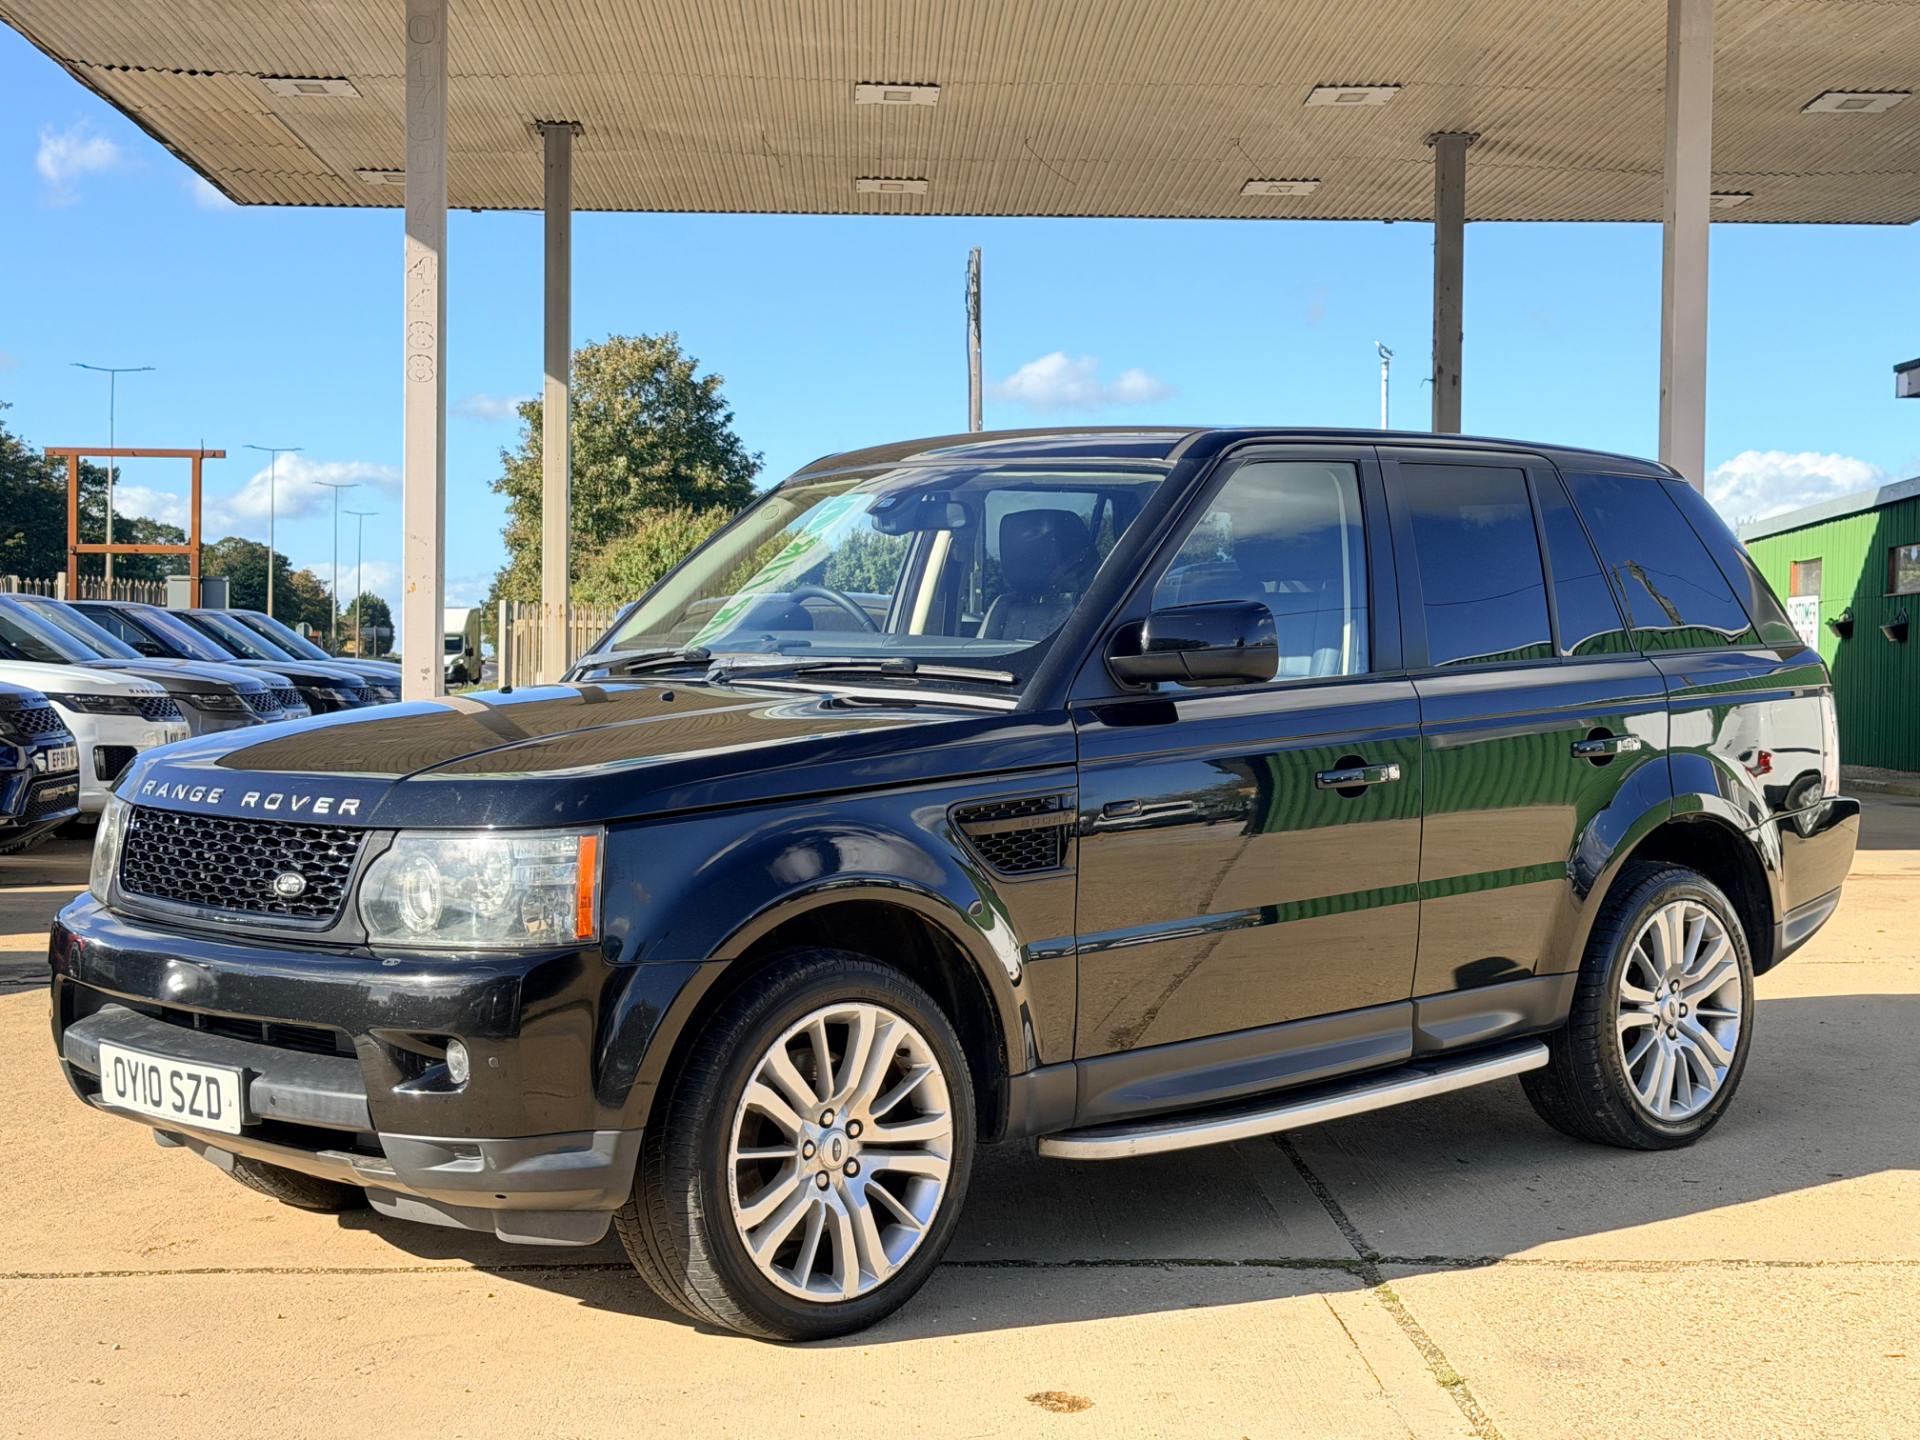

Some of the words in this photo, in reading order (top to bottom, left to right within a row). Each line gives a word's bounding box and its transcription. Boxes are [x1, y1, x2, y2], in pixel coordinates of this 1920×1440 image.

[142, 780, 225, 804] RANGE
[241, 792, 361, 816] ROVER
[114, 1056, 162, 1107] OY10
[170, 1070, 222, 1120] SZD
